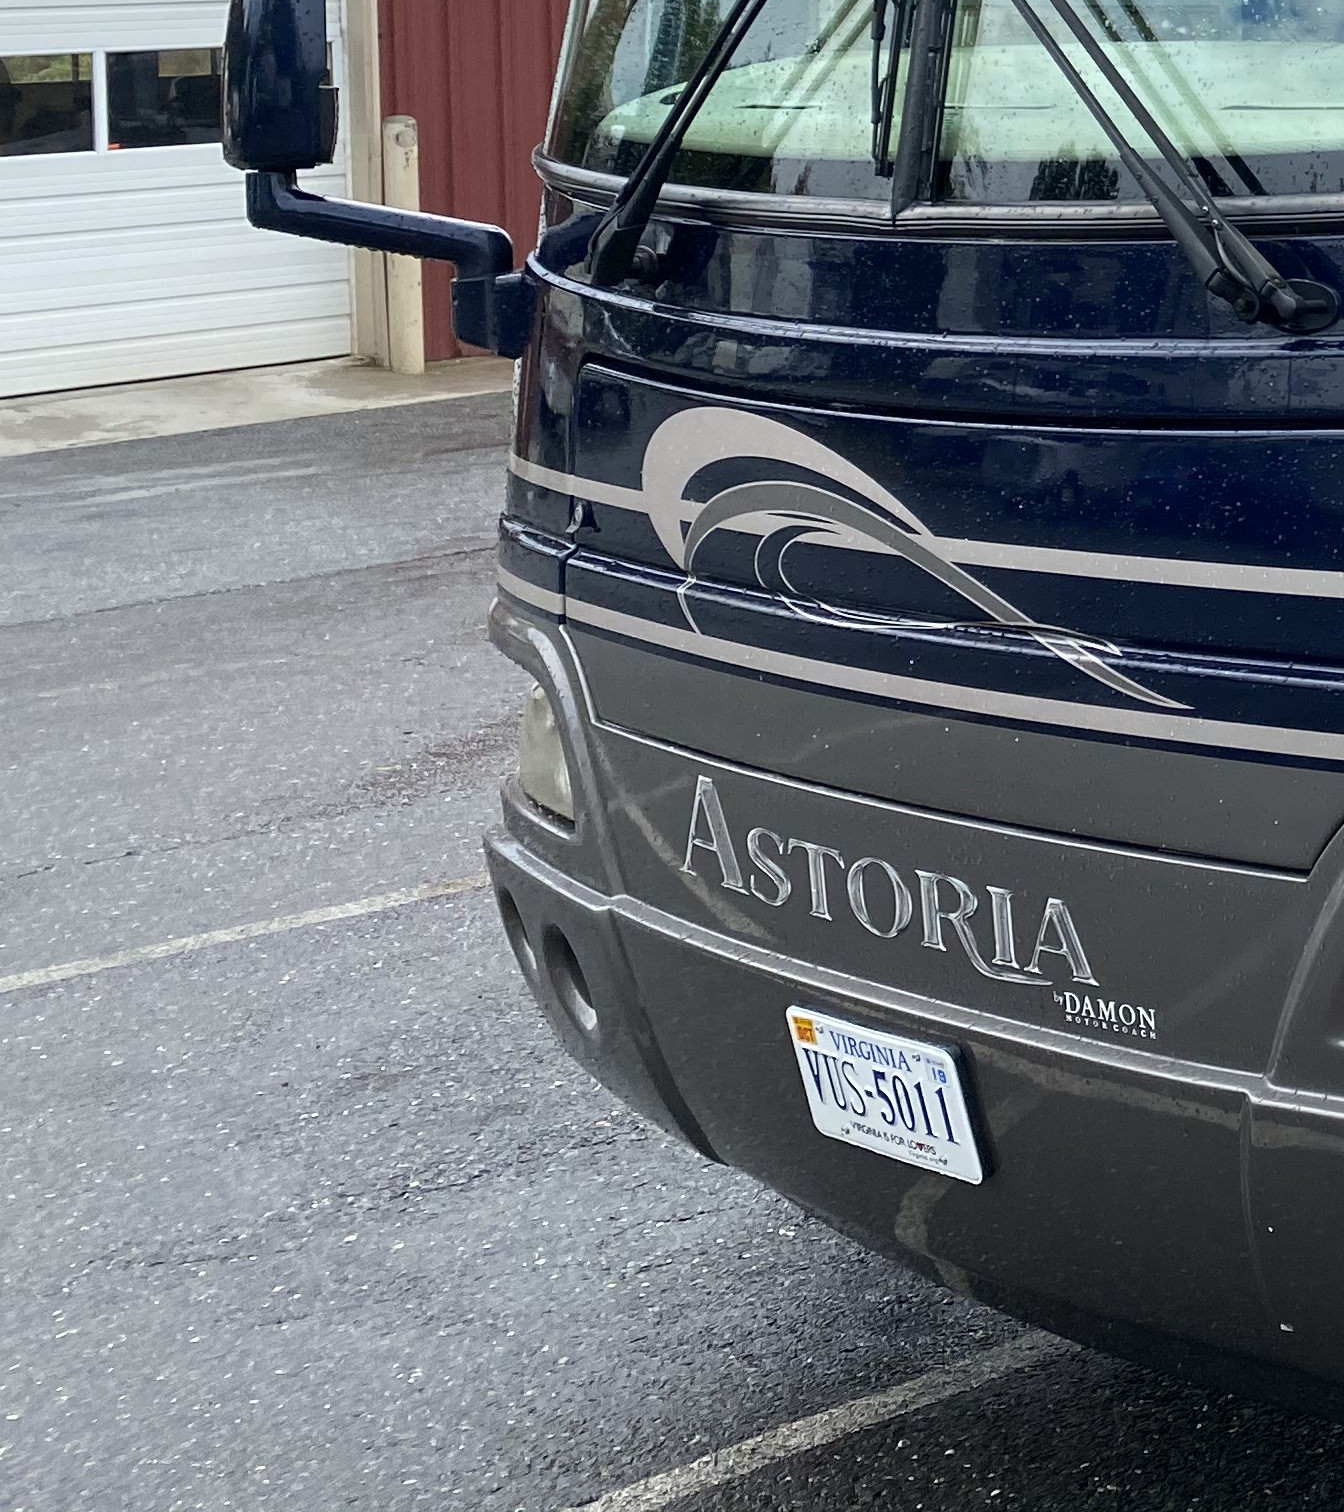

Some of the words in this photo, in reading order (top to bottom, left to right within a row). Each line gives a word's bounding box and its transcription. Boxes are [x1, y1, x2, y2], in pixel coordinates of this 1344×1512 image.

[679, 774, 1100, 986] ASTORIA
[1063, 991, 1155, 1030] DAMON
[829, 1030, 912, 1072] VIRGINIA
[802, 1048, 960, 1146] VUS-5011
